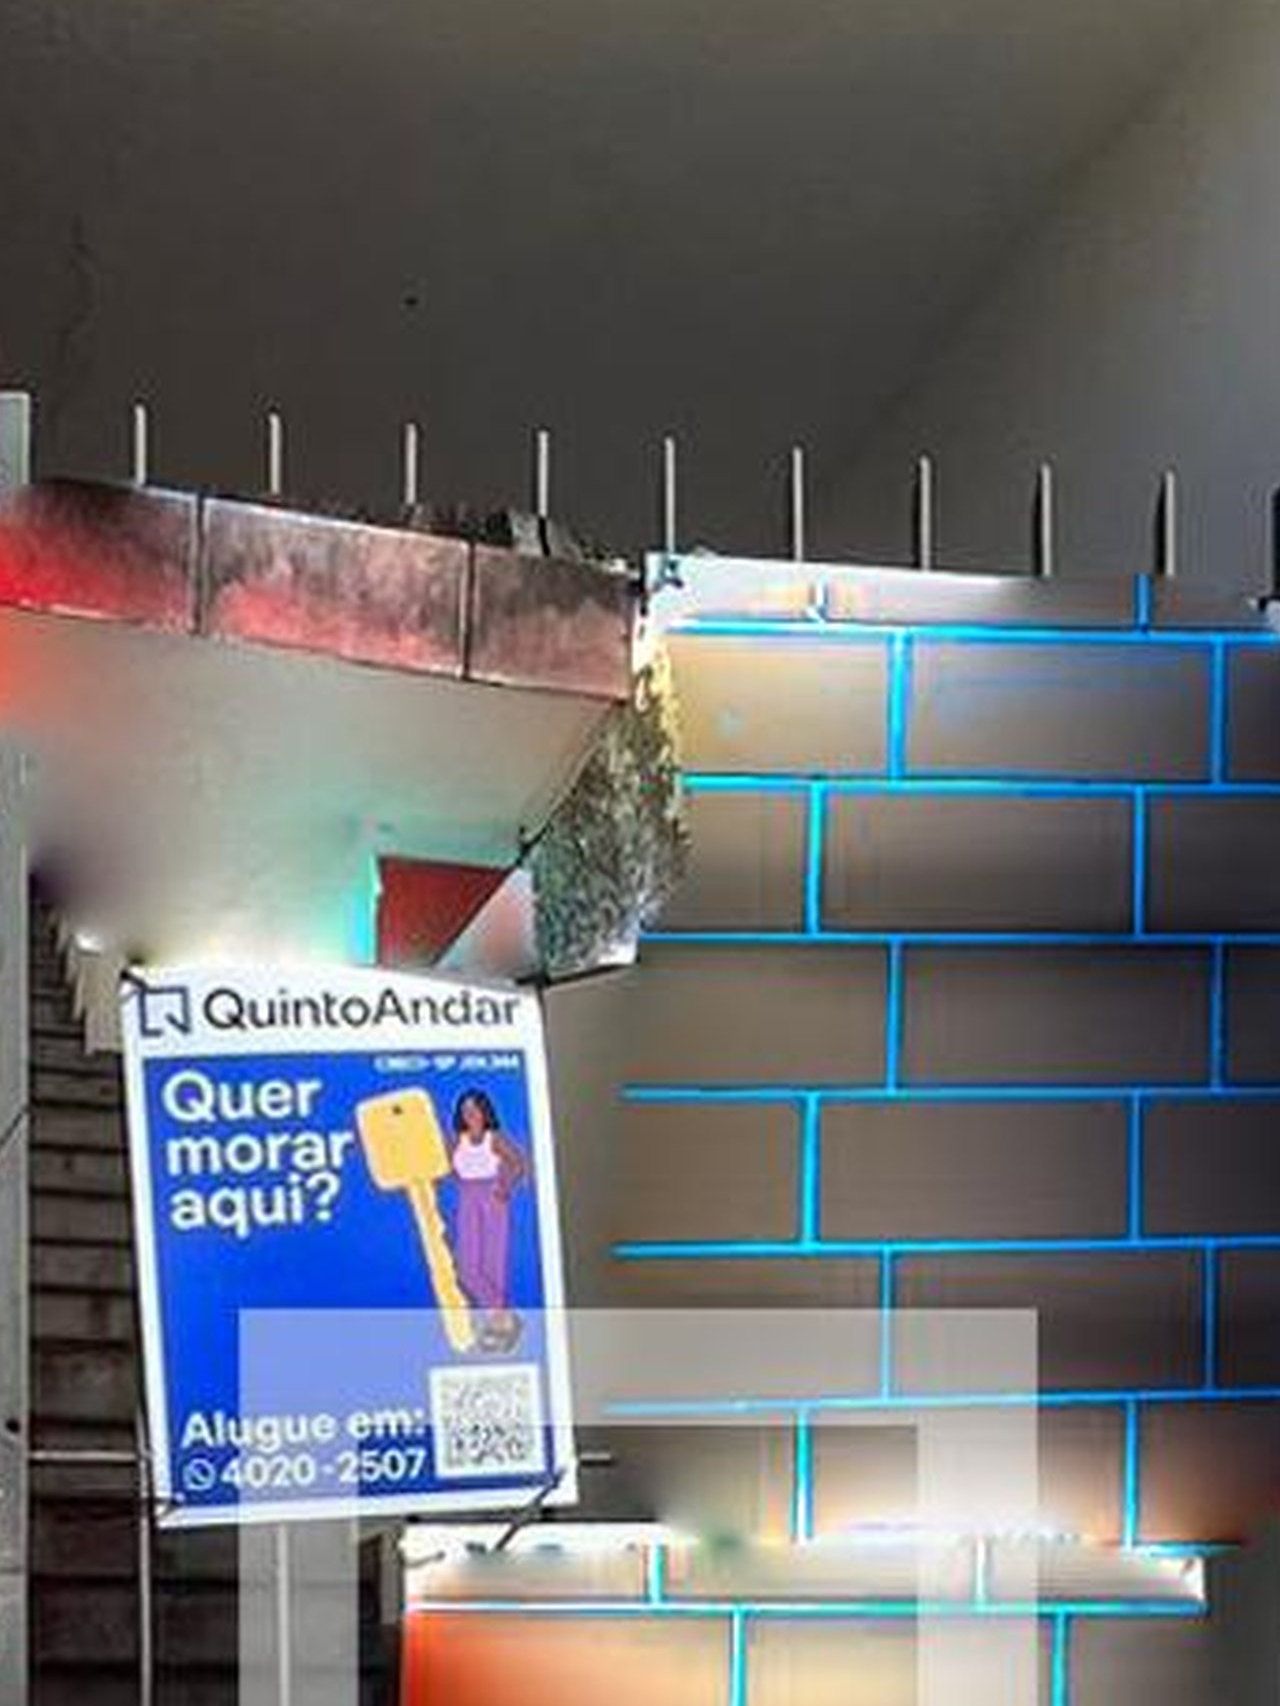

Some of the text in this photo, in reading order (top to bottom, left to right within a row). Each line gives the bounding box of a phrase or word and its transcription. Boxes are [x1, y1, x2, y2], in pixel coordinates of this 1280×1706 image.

[203, 988, 519, 1031] QuintoAndar
[162, 1069, 322, 1123] Quer
[167, 1129, 354, 1176] morar
[169, 1171, 341, 1239] aqui?
[181, 1407, 425, 1453] Alugue em:
[221, 1446, 427, 1488] 4020-2507
